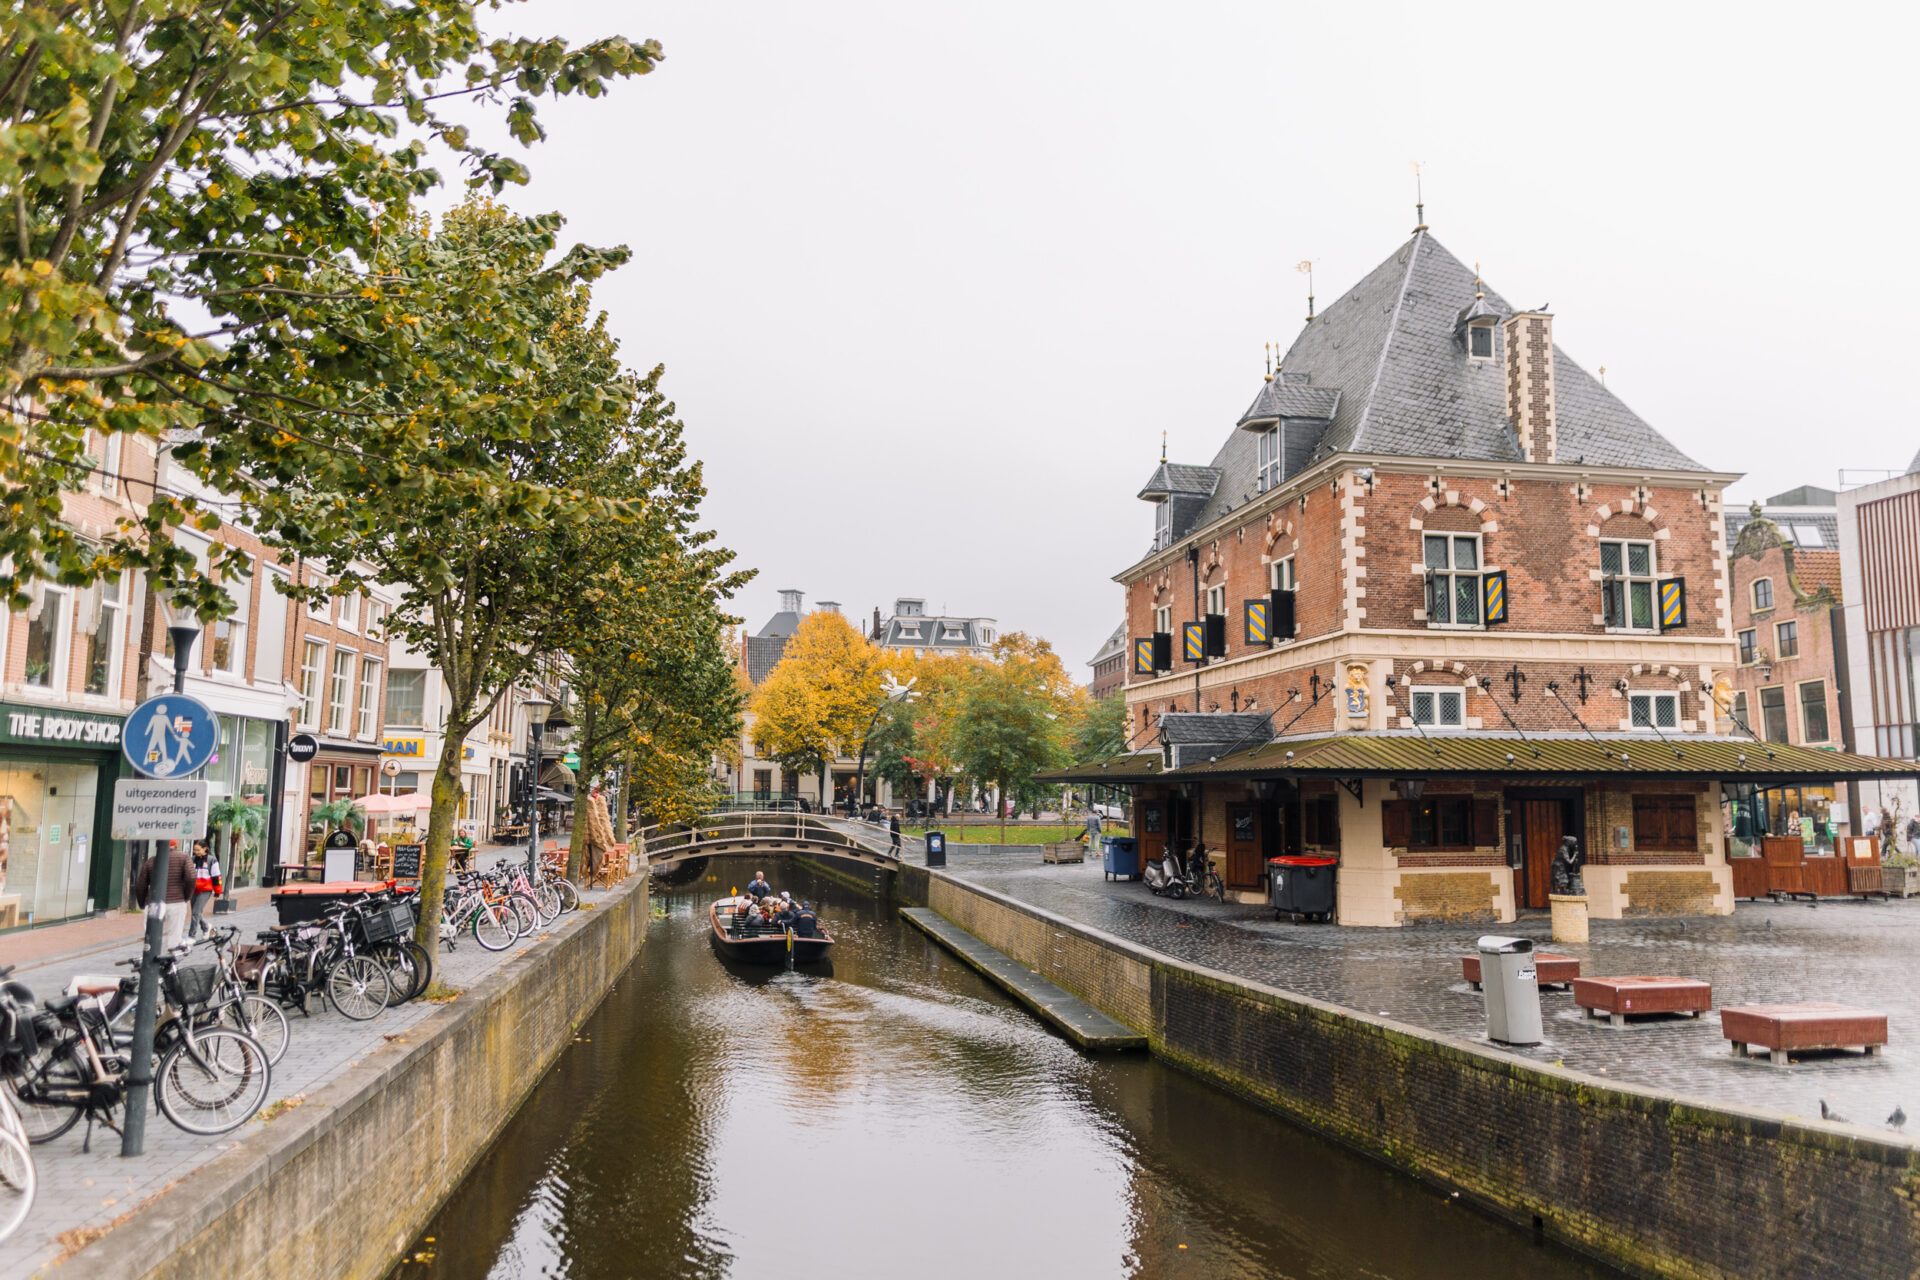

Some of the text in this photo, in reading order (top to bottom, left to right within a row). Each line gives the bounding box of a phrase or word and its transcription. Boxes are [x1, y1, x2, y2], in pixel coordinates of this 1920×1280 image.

[9, 713, 41, 737] THE
[42, 717, 85, 740] BODY
[125, 788, 197, 801] uitgezonderd
[117, 804, 202, 817] bevoorradings-
[138, 820, 180, 830] verkeer
